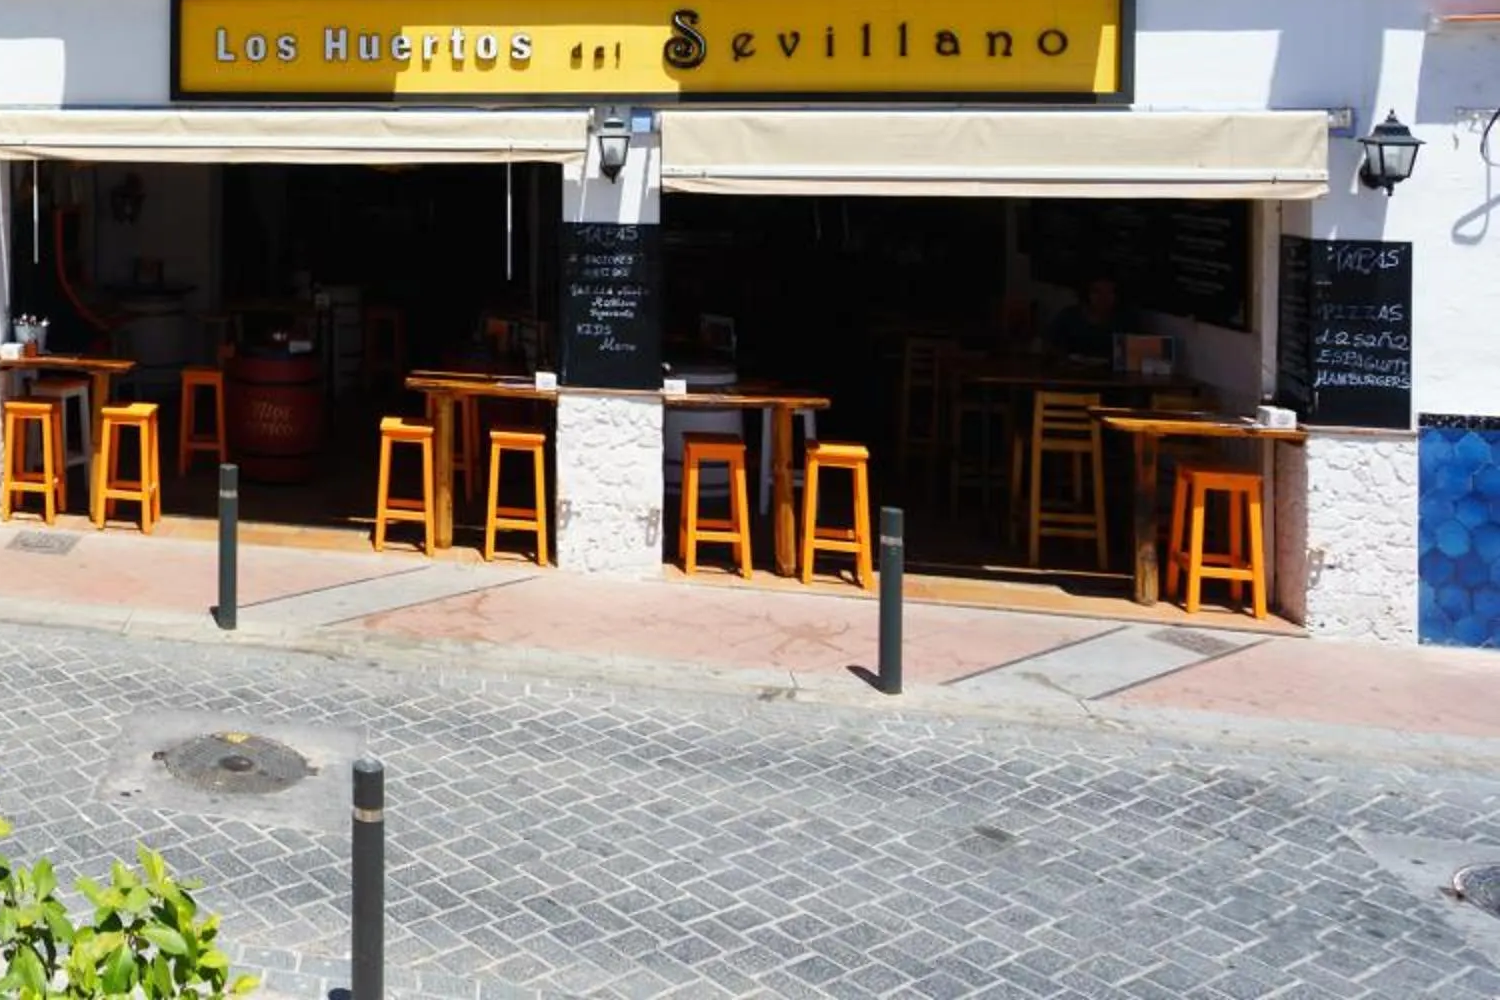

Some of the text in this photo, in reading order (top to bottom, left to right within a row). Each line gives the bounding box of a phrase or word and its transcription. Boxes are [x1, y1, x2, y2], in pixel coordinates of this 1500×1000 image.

[215, 26, 299, 63] Los
[323, 26, 534, 62] Huertos
[663, 8, 1069, 69] Sevillano
[1313, 368, 1412, 389] HAMBURGERS
